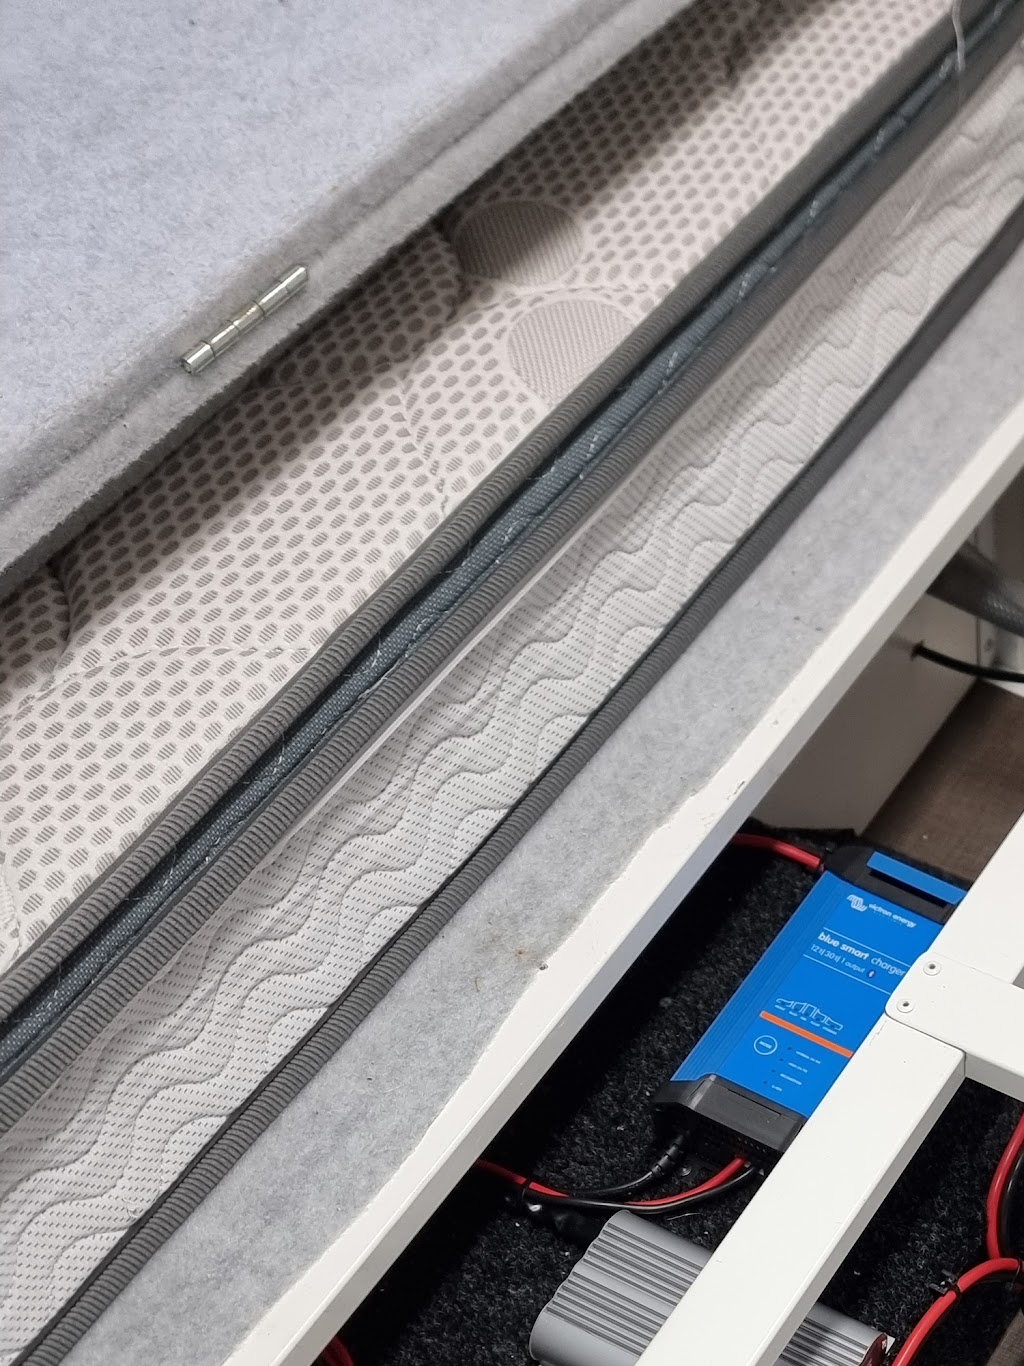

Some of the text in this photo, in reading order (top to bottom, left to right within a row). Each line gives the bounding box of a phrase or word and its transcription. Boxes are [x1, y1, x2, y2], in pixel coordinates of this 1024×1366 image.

[892, 914, 917, 928] energy
[817, 932, 905, 977] blue smart charger
